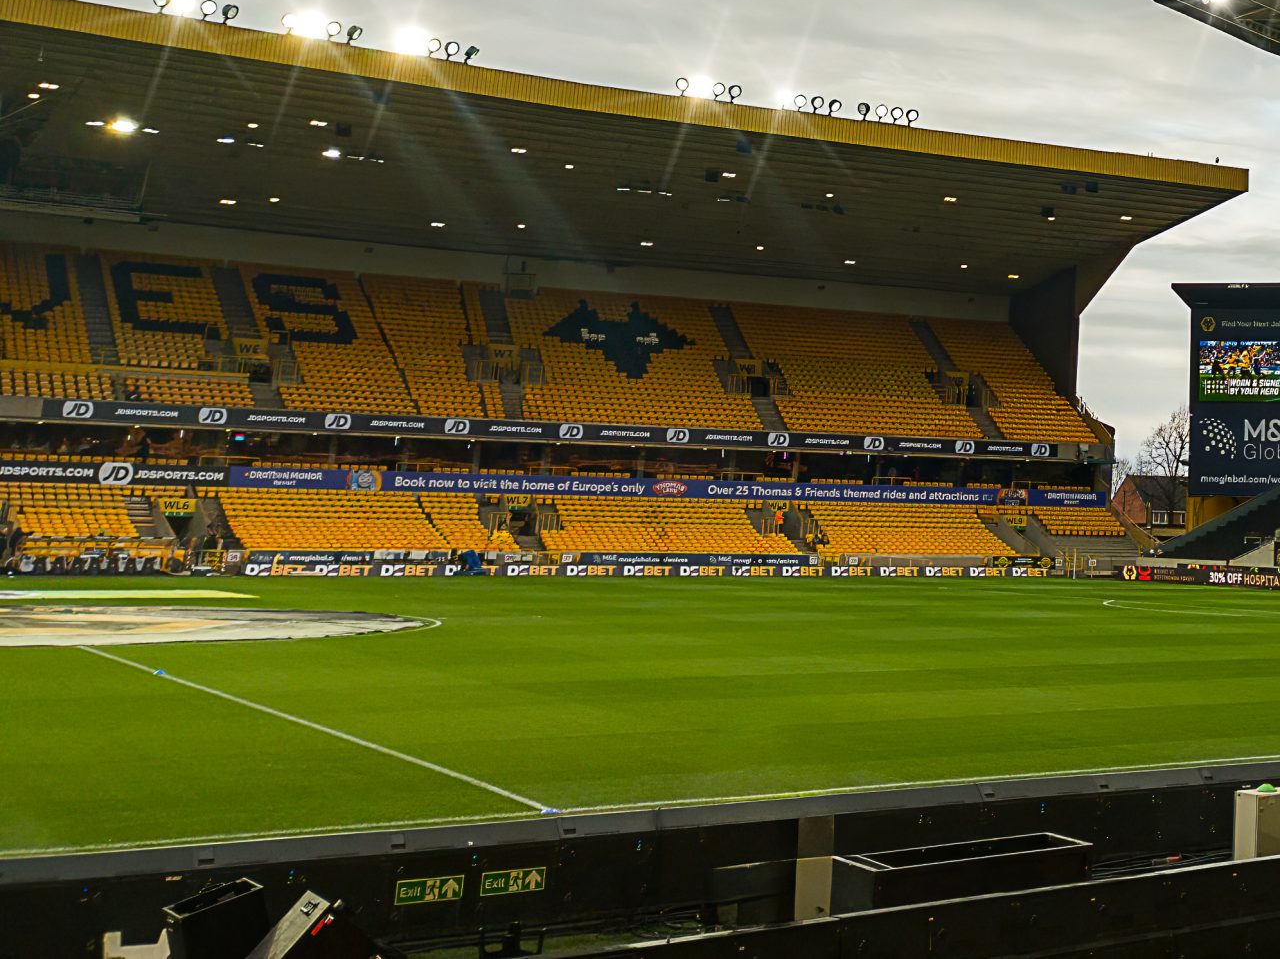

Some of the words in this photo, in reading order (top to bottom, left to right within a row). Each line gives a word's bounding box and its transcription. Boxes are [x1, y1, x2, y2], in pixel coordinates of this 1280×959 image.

[115, 408, 178, 418] JDSPORTS.COM
[135, 469, 224, 480] JDSPORTS.COM
[395, 476, 426, 488] Book
[428, 479, 454, 488] now
[458, 479, 470, 489] to
[473, 479, 497, 489] visit
[500, 479, 519, 490] the
[522, 480, 554, 491] home
[557, 480, 570, 491] of
[572, 481, 619, 494] Europe's
[621, 484, 646, 495] only
[708, 485, 734, 495] Over
[736, 486, 749, 495] 25
[752, 486, 792, 496] Thomas
[795, 487, 802, 497] &
[805, 487, 841, 498] Friends
[844, 489, 881, 499] themed
[883, 489, 906, 499] rides
[909, 490, 927, 500] and
[929, 492, 979, 501] attractions
[164, 500, 189, 510] WL6
[507, 496, 528, 505] WL7
[1006, 516, 1023, 525] WL9
[1209, 572, 1225, 583] 30%
[1227, 572, 1242, 584] OFF
[485, 877, 504, 889] Exit
[400, 886, 421, 898] Exit
